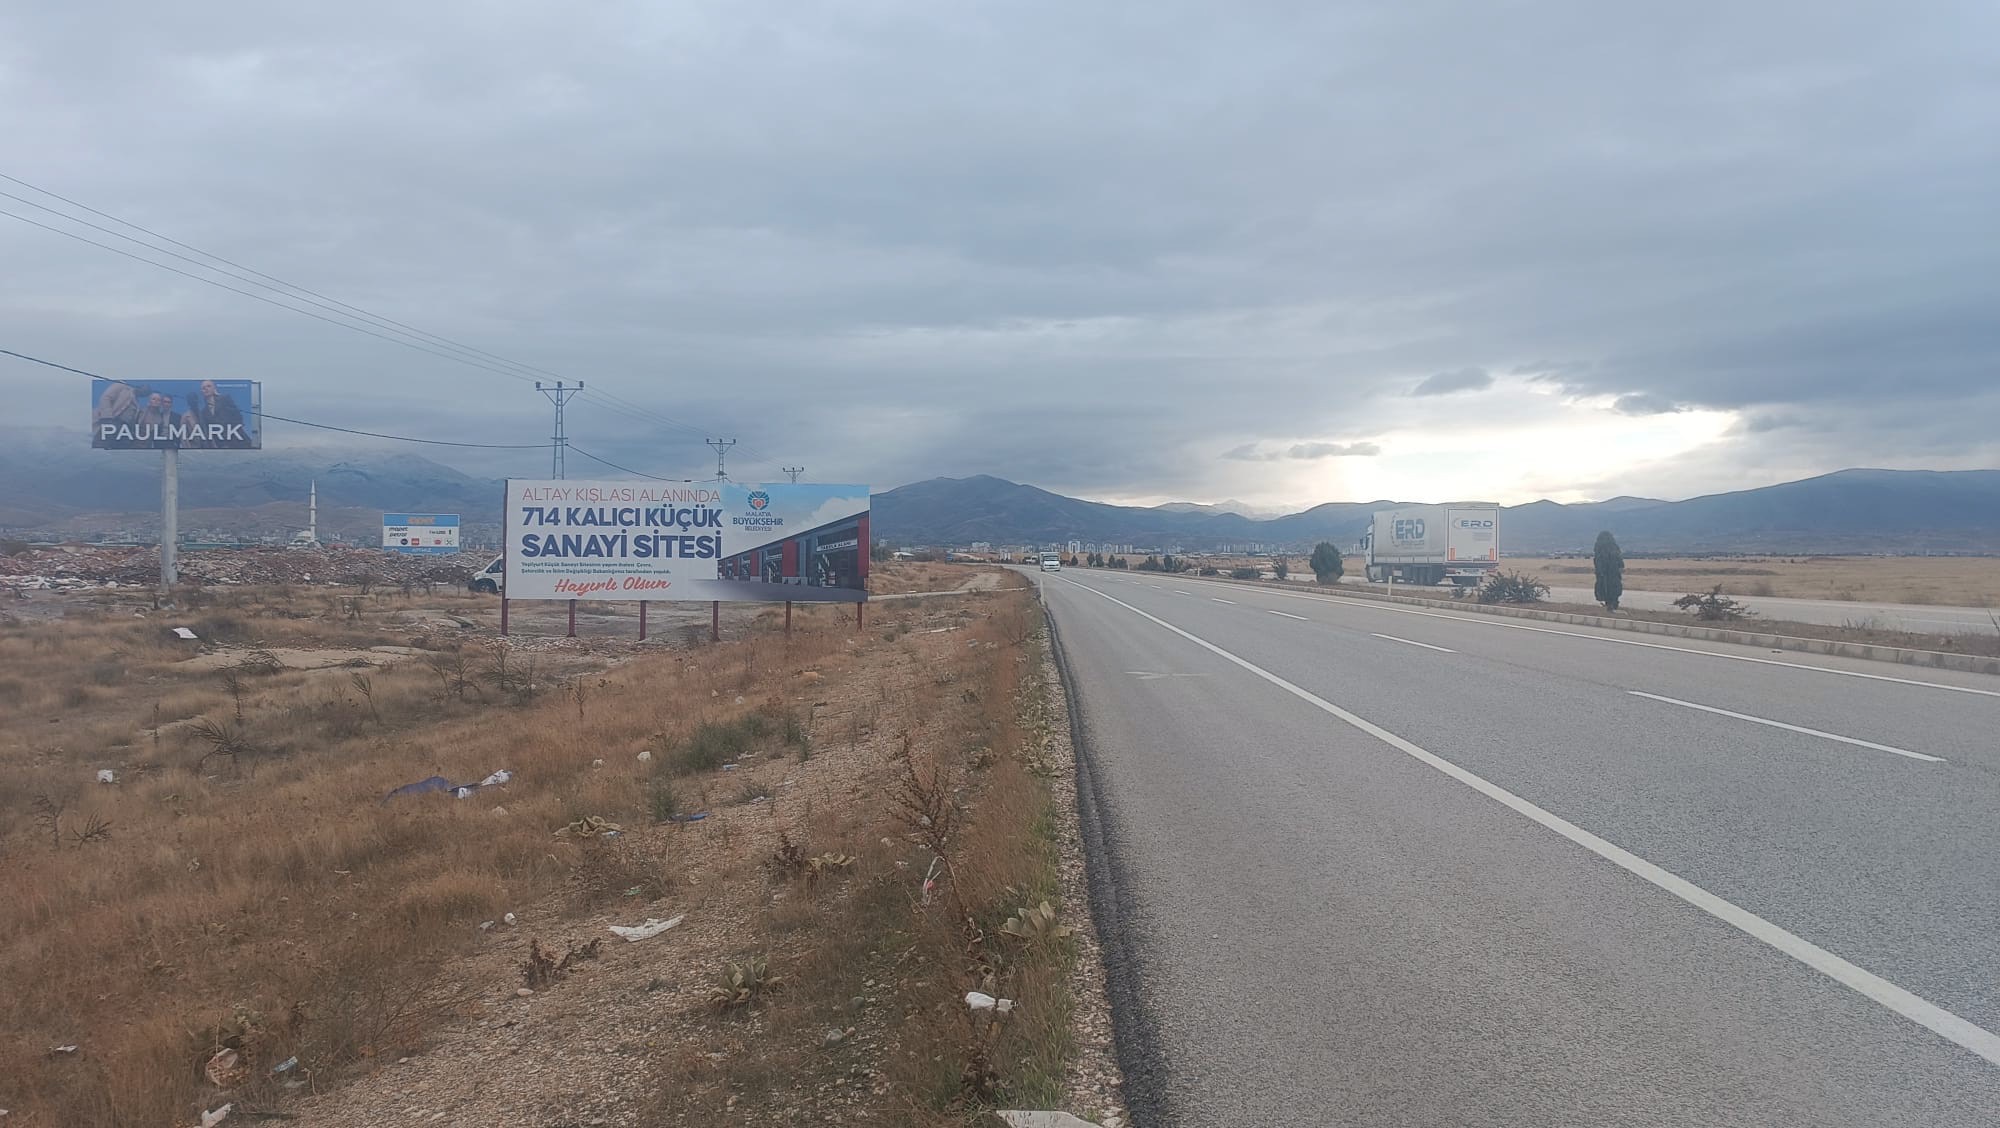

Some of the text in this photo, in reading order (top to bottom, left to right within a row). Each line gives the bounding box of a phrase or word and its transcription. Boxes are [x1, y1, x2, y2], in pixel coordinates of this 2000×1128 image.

[101, 424, 244, 441] PAULMARK
[522, 488, 721, 504] ALTAY KIŞLASI ALANINDA
[522, 504, 723, 532] 714 KALICI KÜÇÜK
[1460, 520, 1493, 528] ERD
[1395, 518, 1425, 539] ERD
[521, 529, 722, 559] SANAYİ SİTESİ
[554, 577, 671, 596] Hayırlı Olsun
